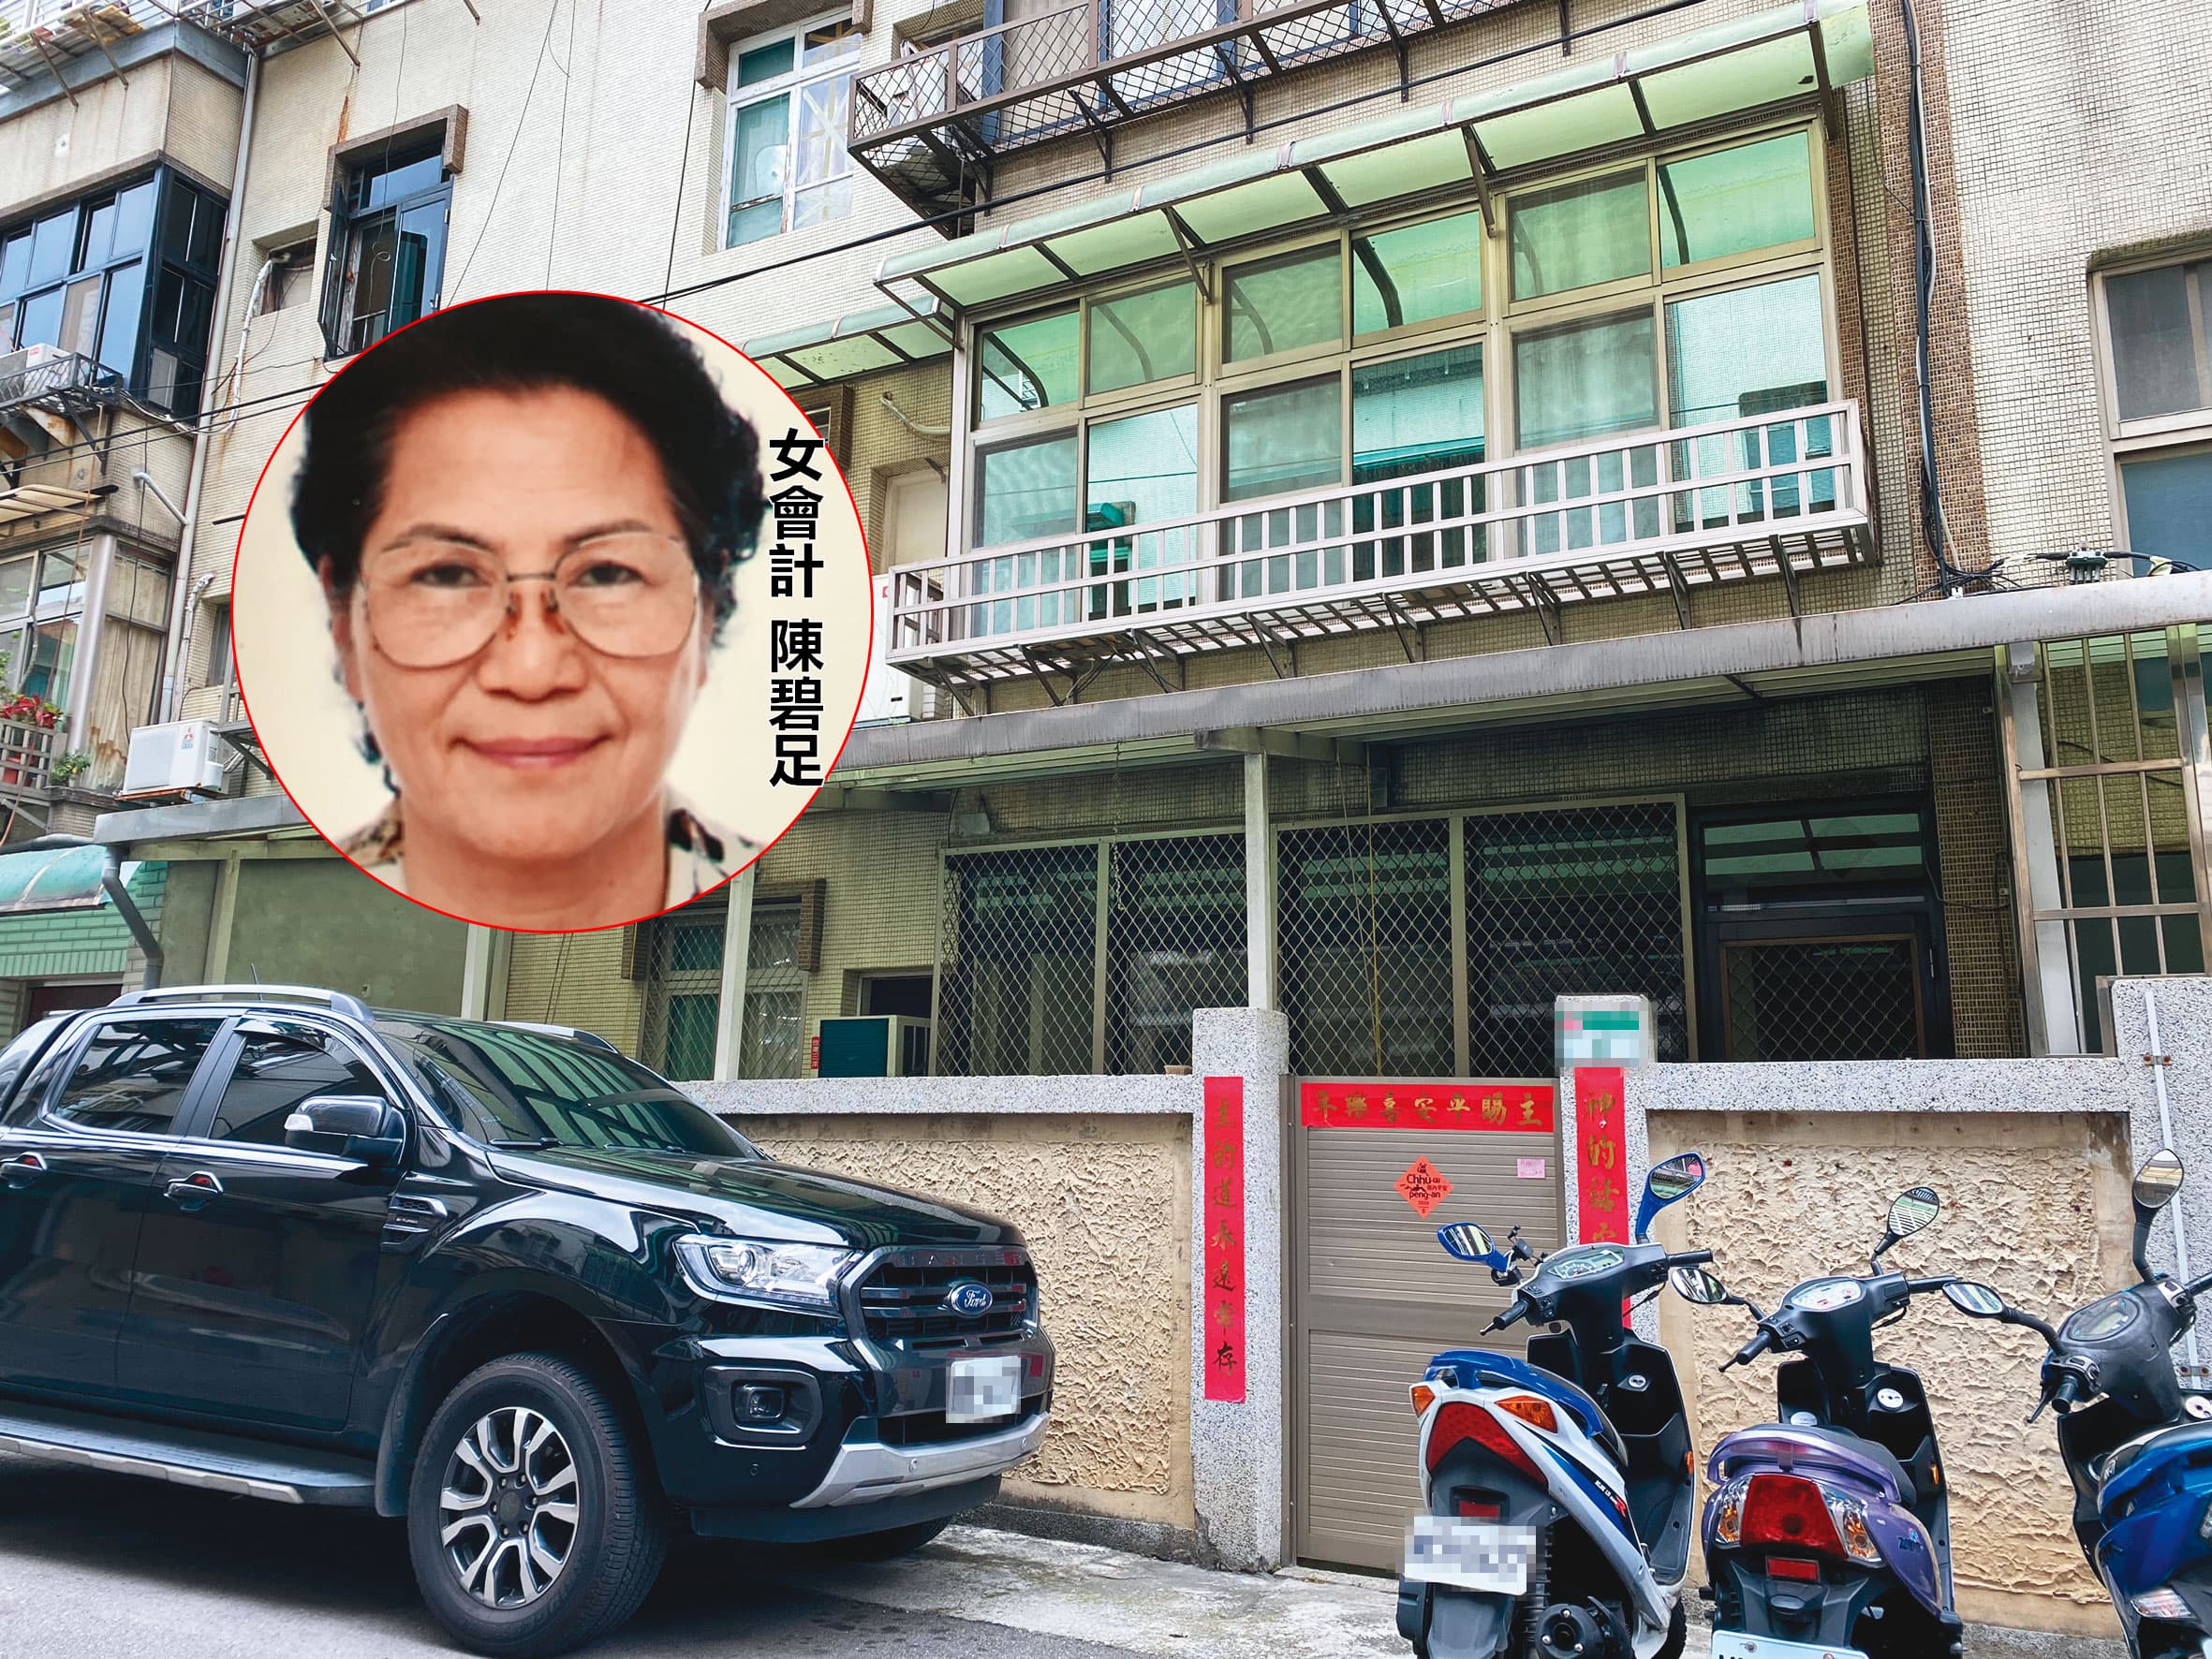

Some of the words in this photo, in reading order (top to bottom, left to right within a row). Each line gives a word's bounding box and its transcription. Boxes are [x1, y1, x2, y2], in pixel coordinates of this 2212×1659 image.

[964, 1289, 987, 1309] Ford
[1211, 1097, 1237, 1376] 主的道永遠常存
